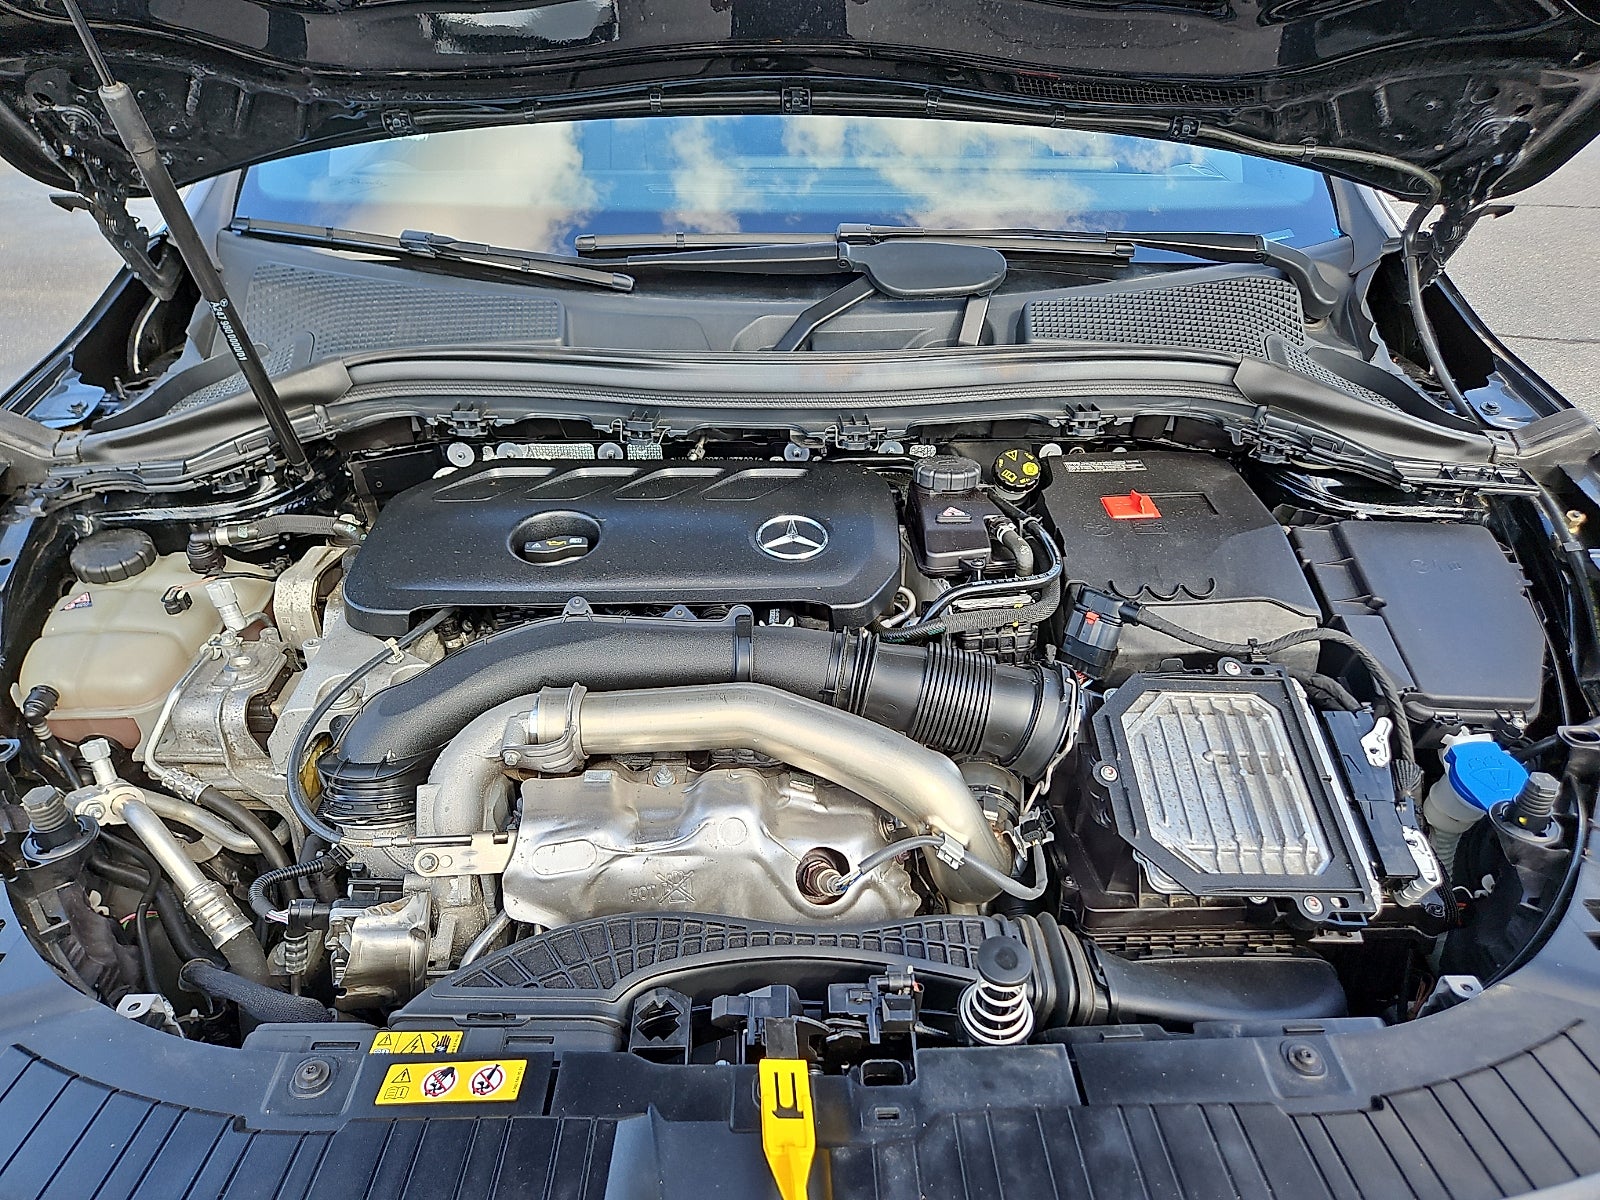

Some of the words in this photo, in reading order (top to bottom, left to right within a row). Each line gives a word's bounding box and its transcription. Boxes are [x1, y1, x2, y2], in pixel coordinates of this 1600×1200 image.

[211, 302, 226, 320] A247
[221, 321, 233, 334] 980
[629, 884, 657, 903] HOT
